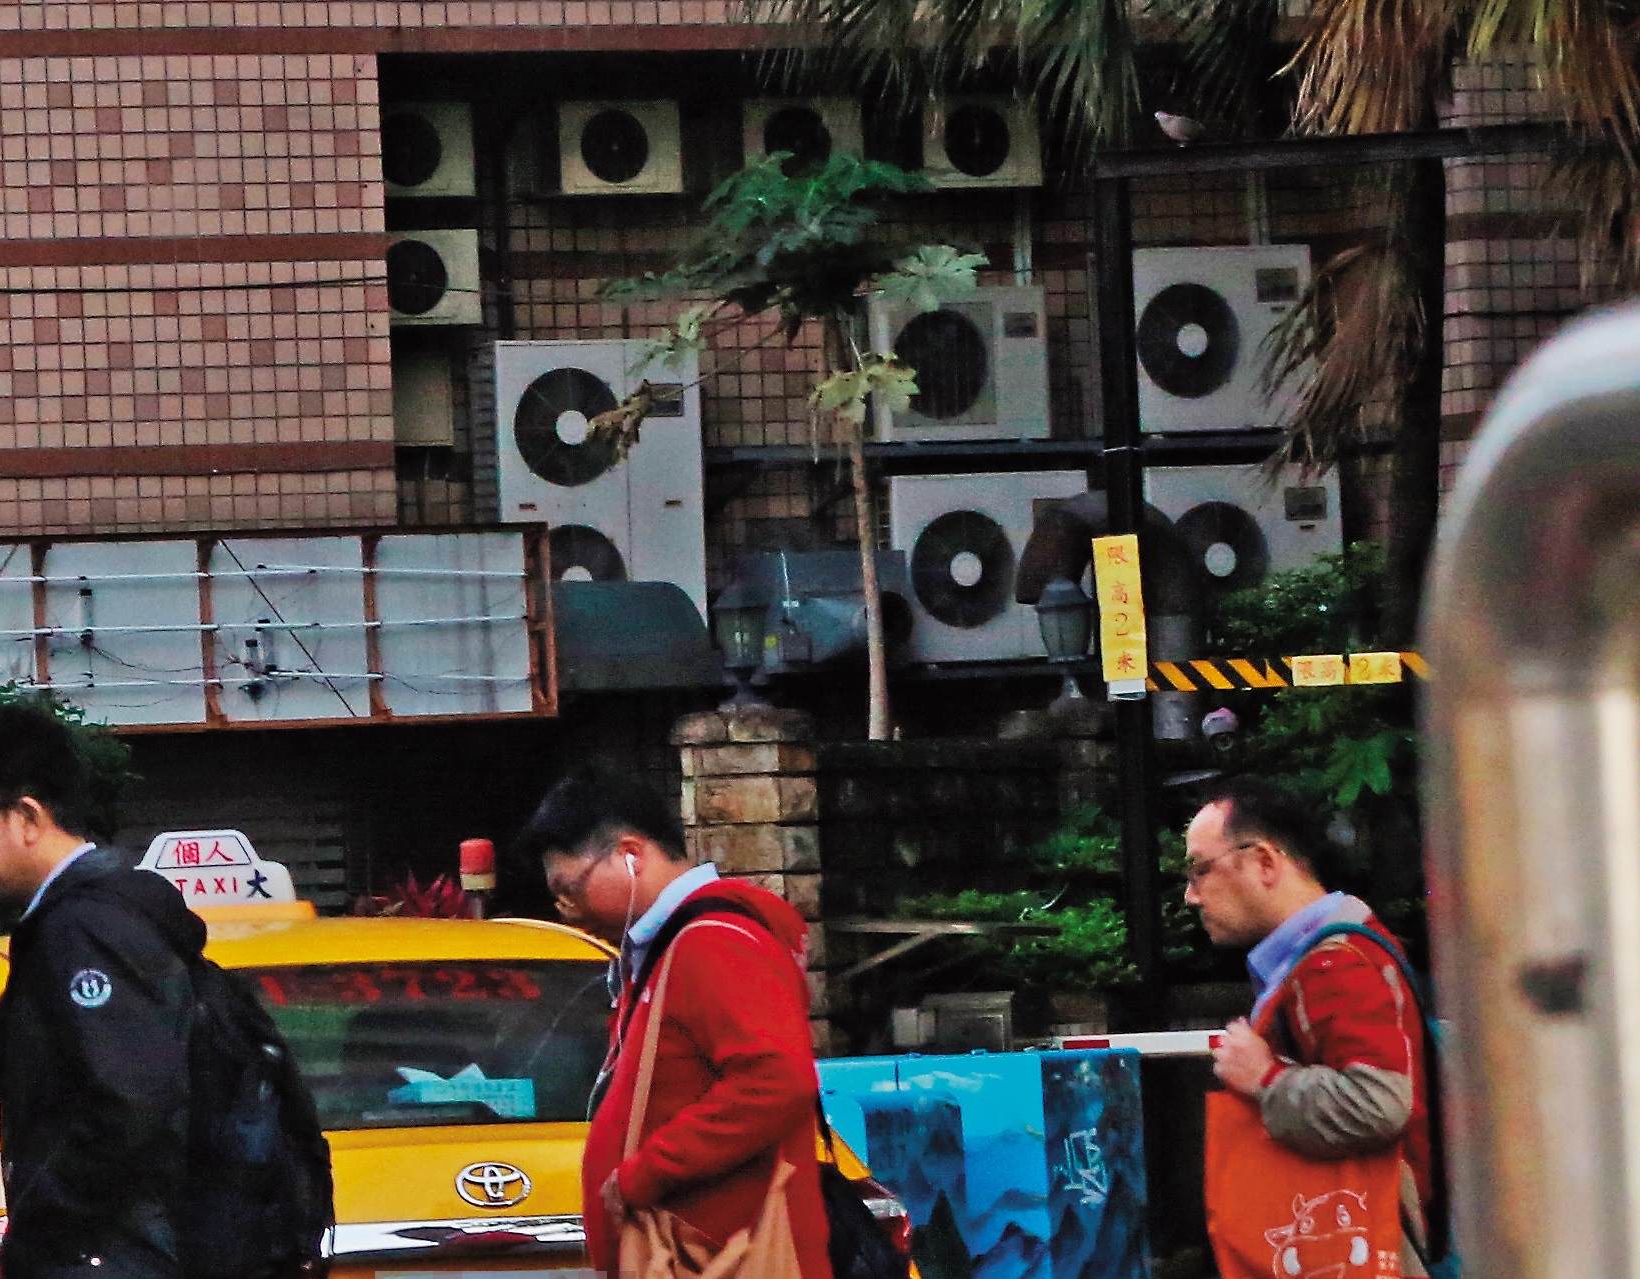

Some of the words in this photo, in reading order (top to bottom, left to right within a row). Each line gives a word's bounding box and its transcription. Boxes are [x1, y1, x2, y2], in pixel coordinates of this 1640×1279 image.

[174, 840, 234, 865] 個人
[175, 877, 239, 895] TAXI
[246, 869, 272, 898] 大
